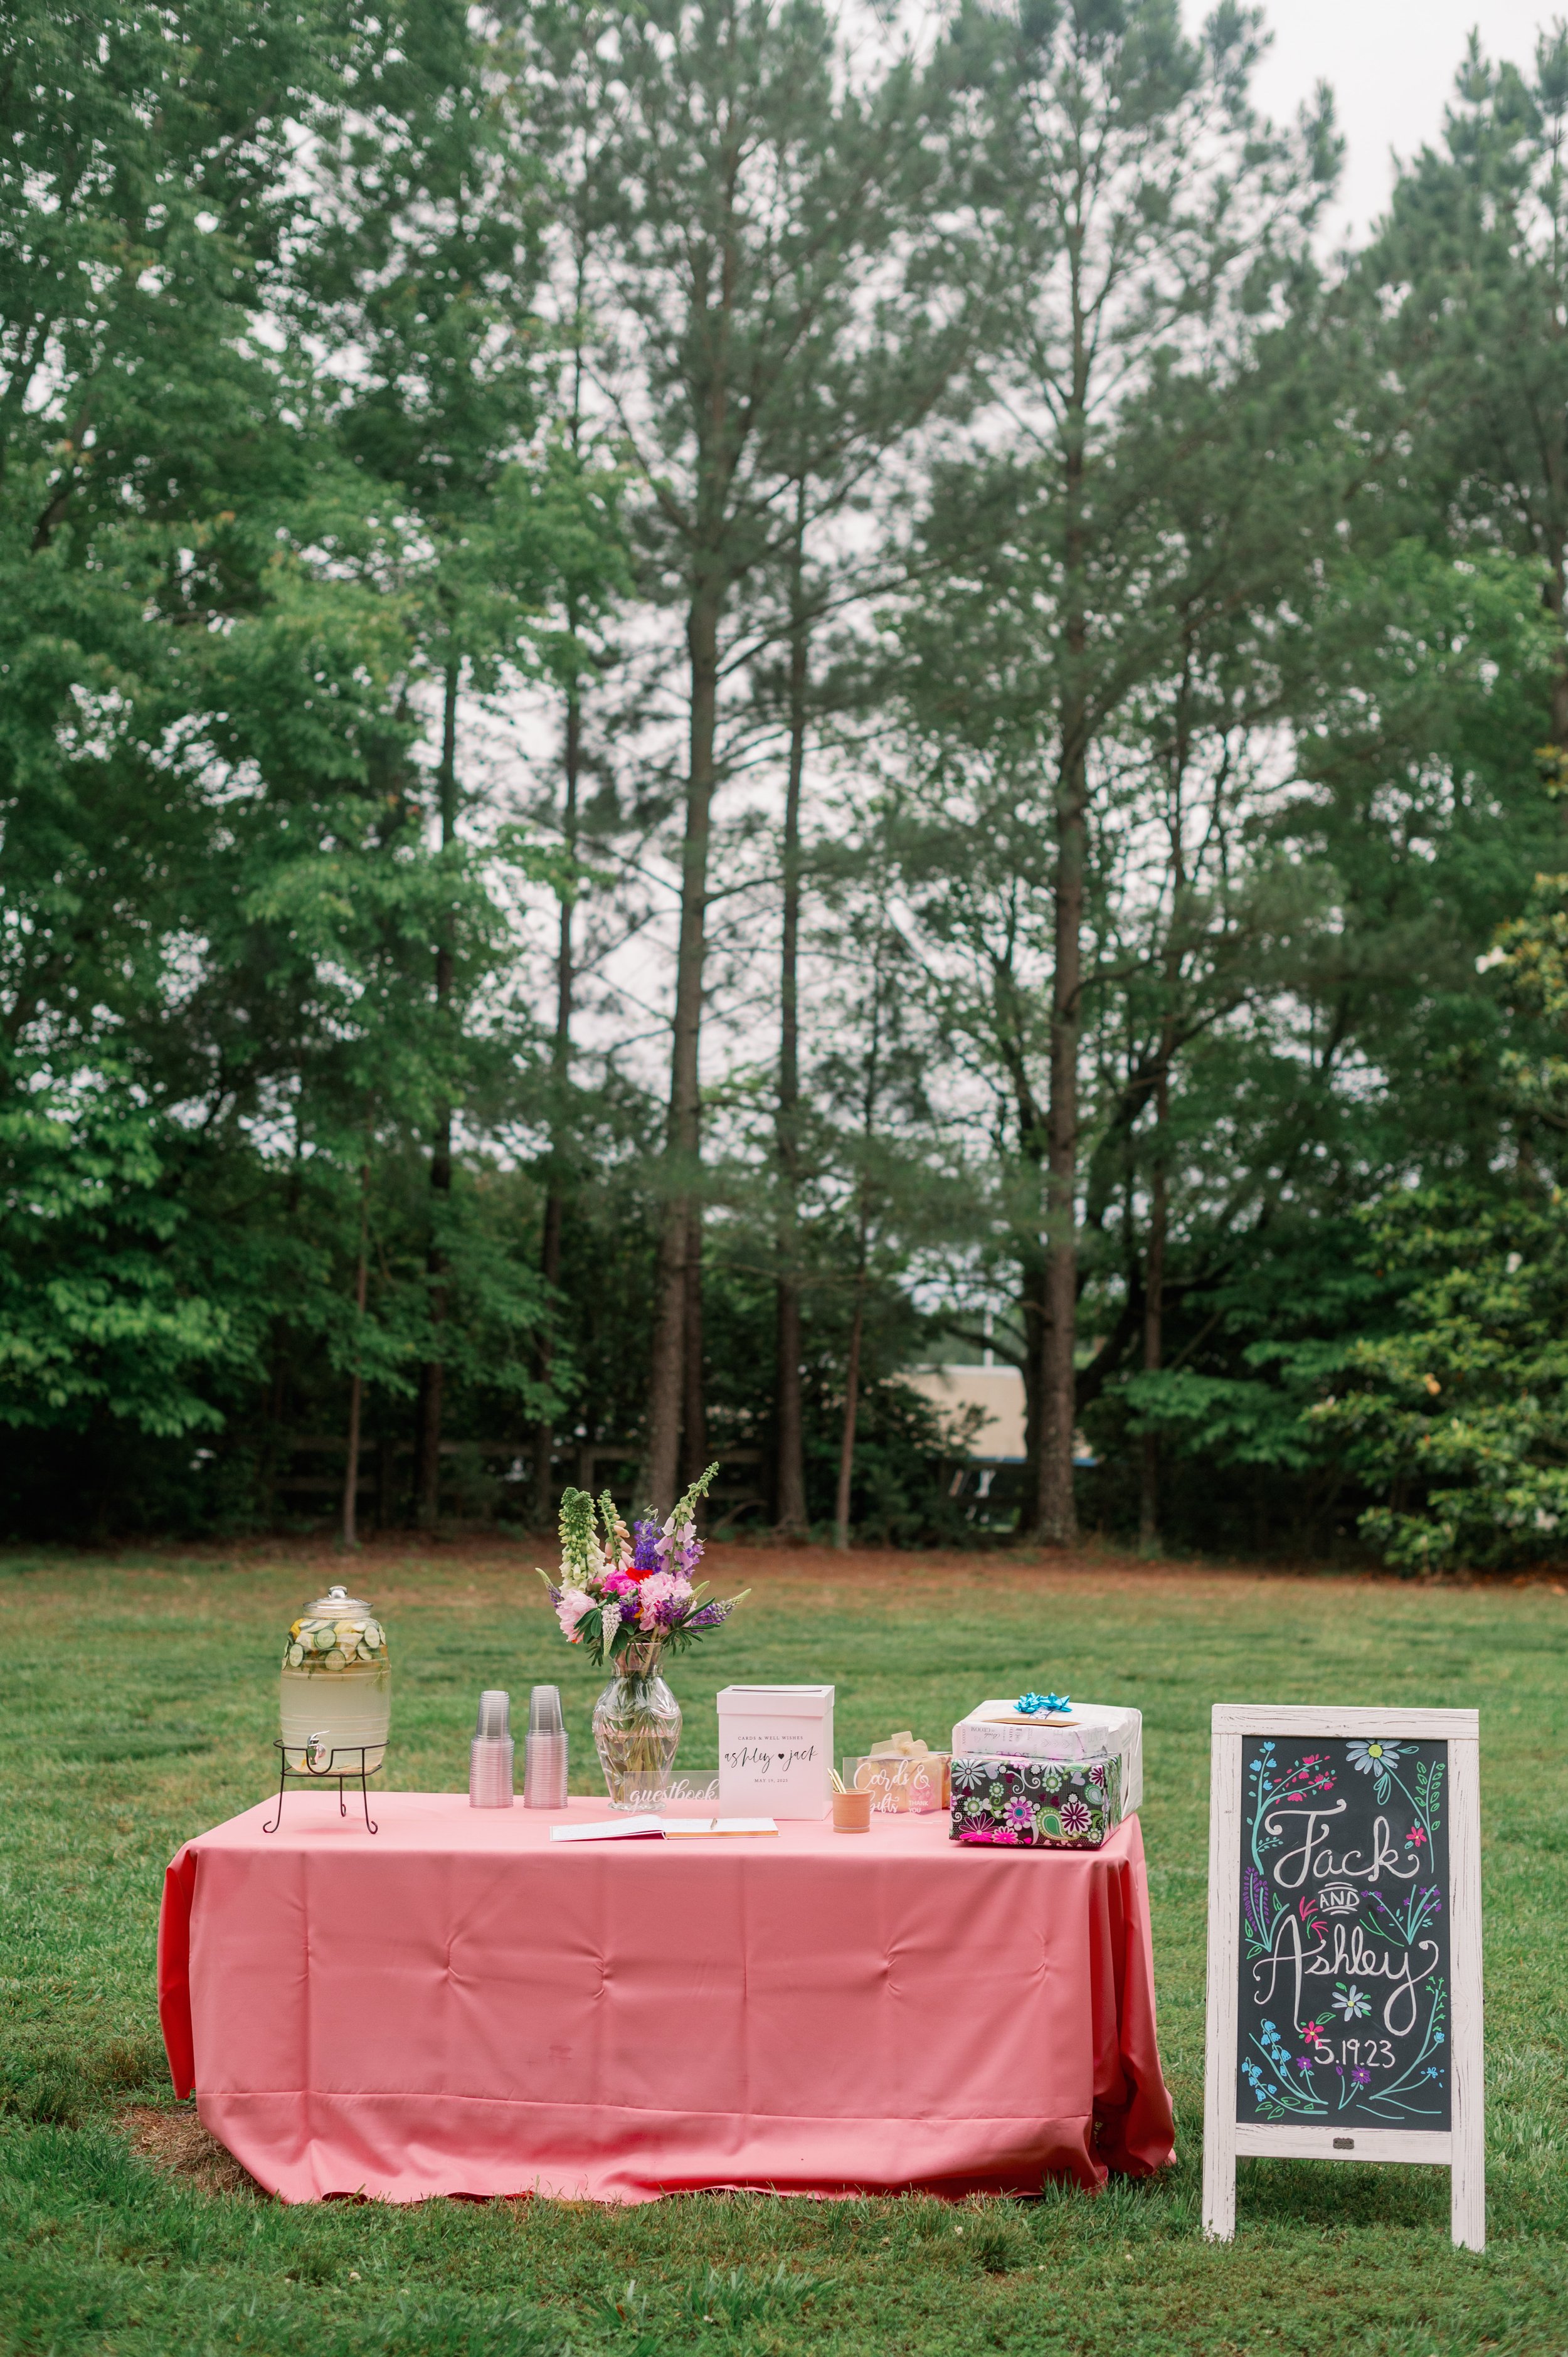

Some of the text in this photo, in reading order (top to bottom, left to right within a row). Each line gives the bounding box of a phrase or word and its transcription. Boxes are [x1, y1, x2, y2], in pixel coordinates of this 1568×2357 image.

[724, 1745, 818, 1774] ashley jack
[853, 1759, 931, 1791] Cards &
[628, 1779, 720, 1816] guestbook
[1264, 1798, 1420, 1889] Jack
[1319, 1890, 1360, 1909] AND
[1253, 1914, 1439, 2036] Ashley
[1314, 2038, 1396, 2068] 5.19.23
